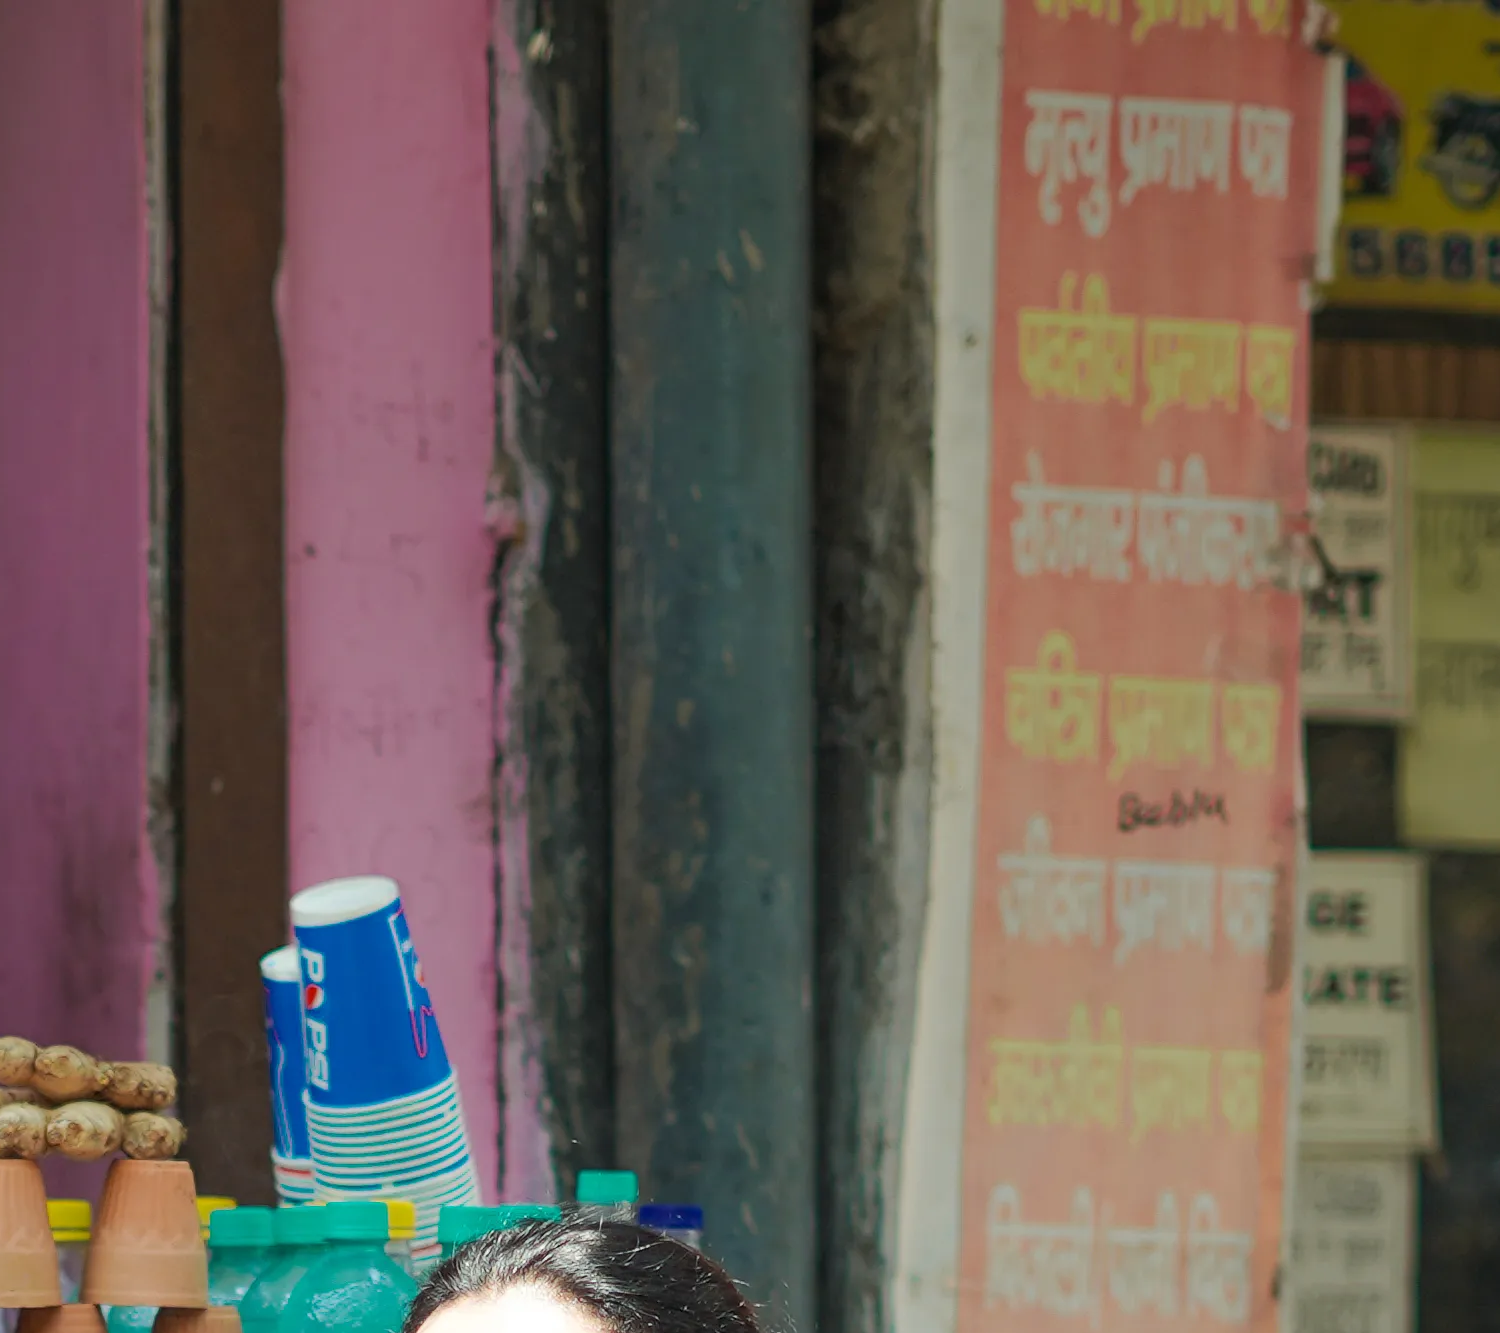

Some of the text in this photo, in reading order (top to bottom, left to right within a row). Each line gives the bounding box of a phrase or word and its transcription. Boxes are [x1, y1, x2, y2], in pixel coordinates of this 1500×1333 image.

[1024, 88, 1293, 237] मृत्यु प्रमाण पत्र
[1141, 315, 1241, 424] प्रमाण
[1107, 674, 1215, 784] प्रमाण
[1221, 682, 1283, 775] पत्र
[1113, 859, 1215, 967] प्रमाण
[1221, 866, 1277, 956] पत्र
[1127, 1045, 1213, 1148] प्रमाण
